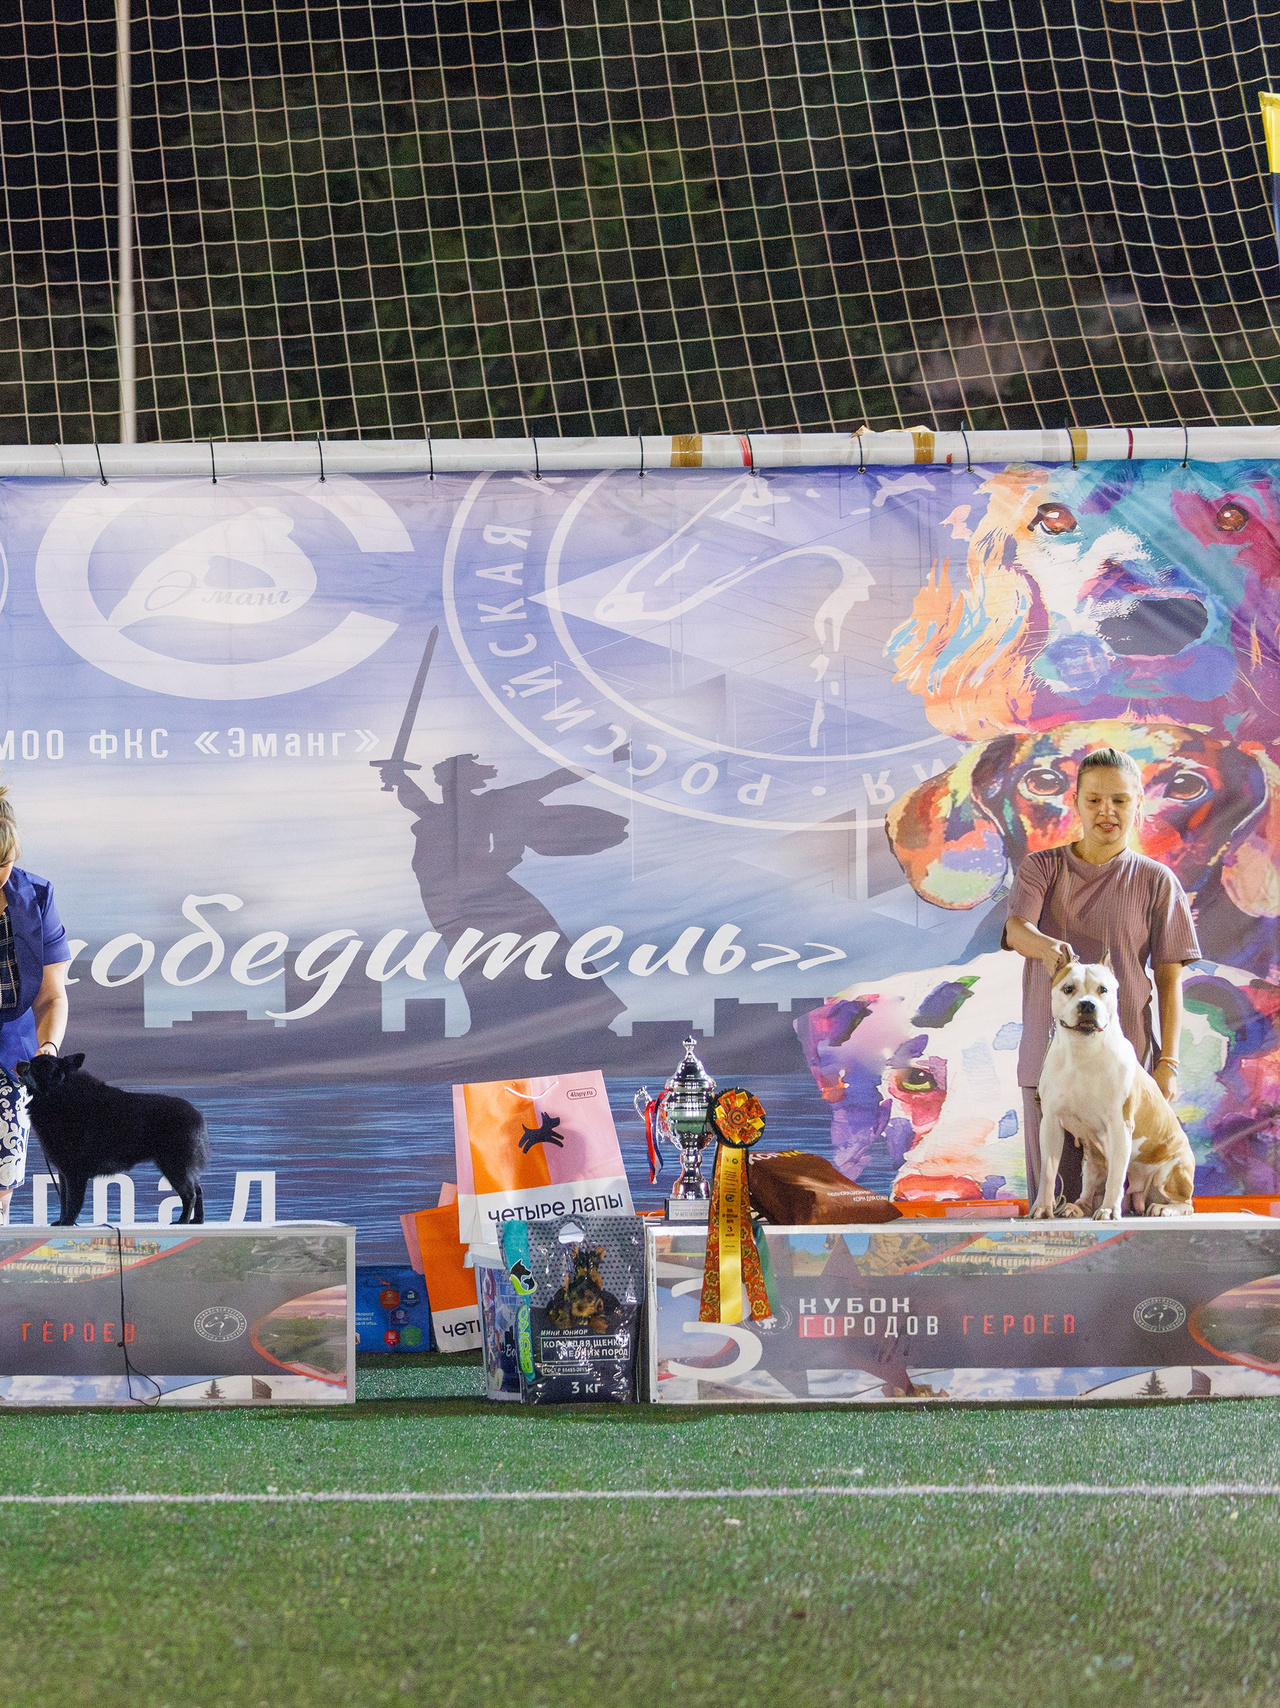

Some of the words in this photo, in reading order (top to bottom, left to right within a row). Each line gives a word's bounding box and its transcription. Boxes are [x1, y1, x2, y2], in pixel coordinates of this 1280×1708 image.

[474, 522, 773, 807] РОССИЙСКАЯ
[88, 728, 170, 760] ФКС
[194, 726, 381, 759] «Эманг»
[570, 1193, 624, 1216] лапы
[798, 1297, 911, 1314] КУБОК
[21, 1321, 137, 1343] ГЕРОЕВ
[802, 1315, 940, 1338] ГОРОДОВ
[962, 1314, 1076, 1335] ГЕРОЕВ
[601, 1347, 629, 1357] ПОРОД
[571, 1381, 580, 1394] 3
